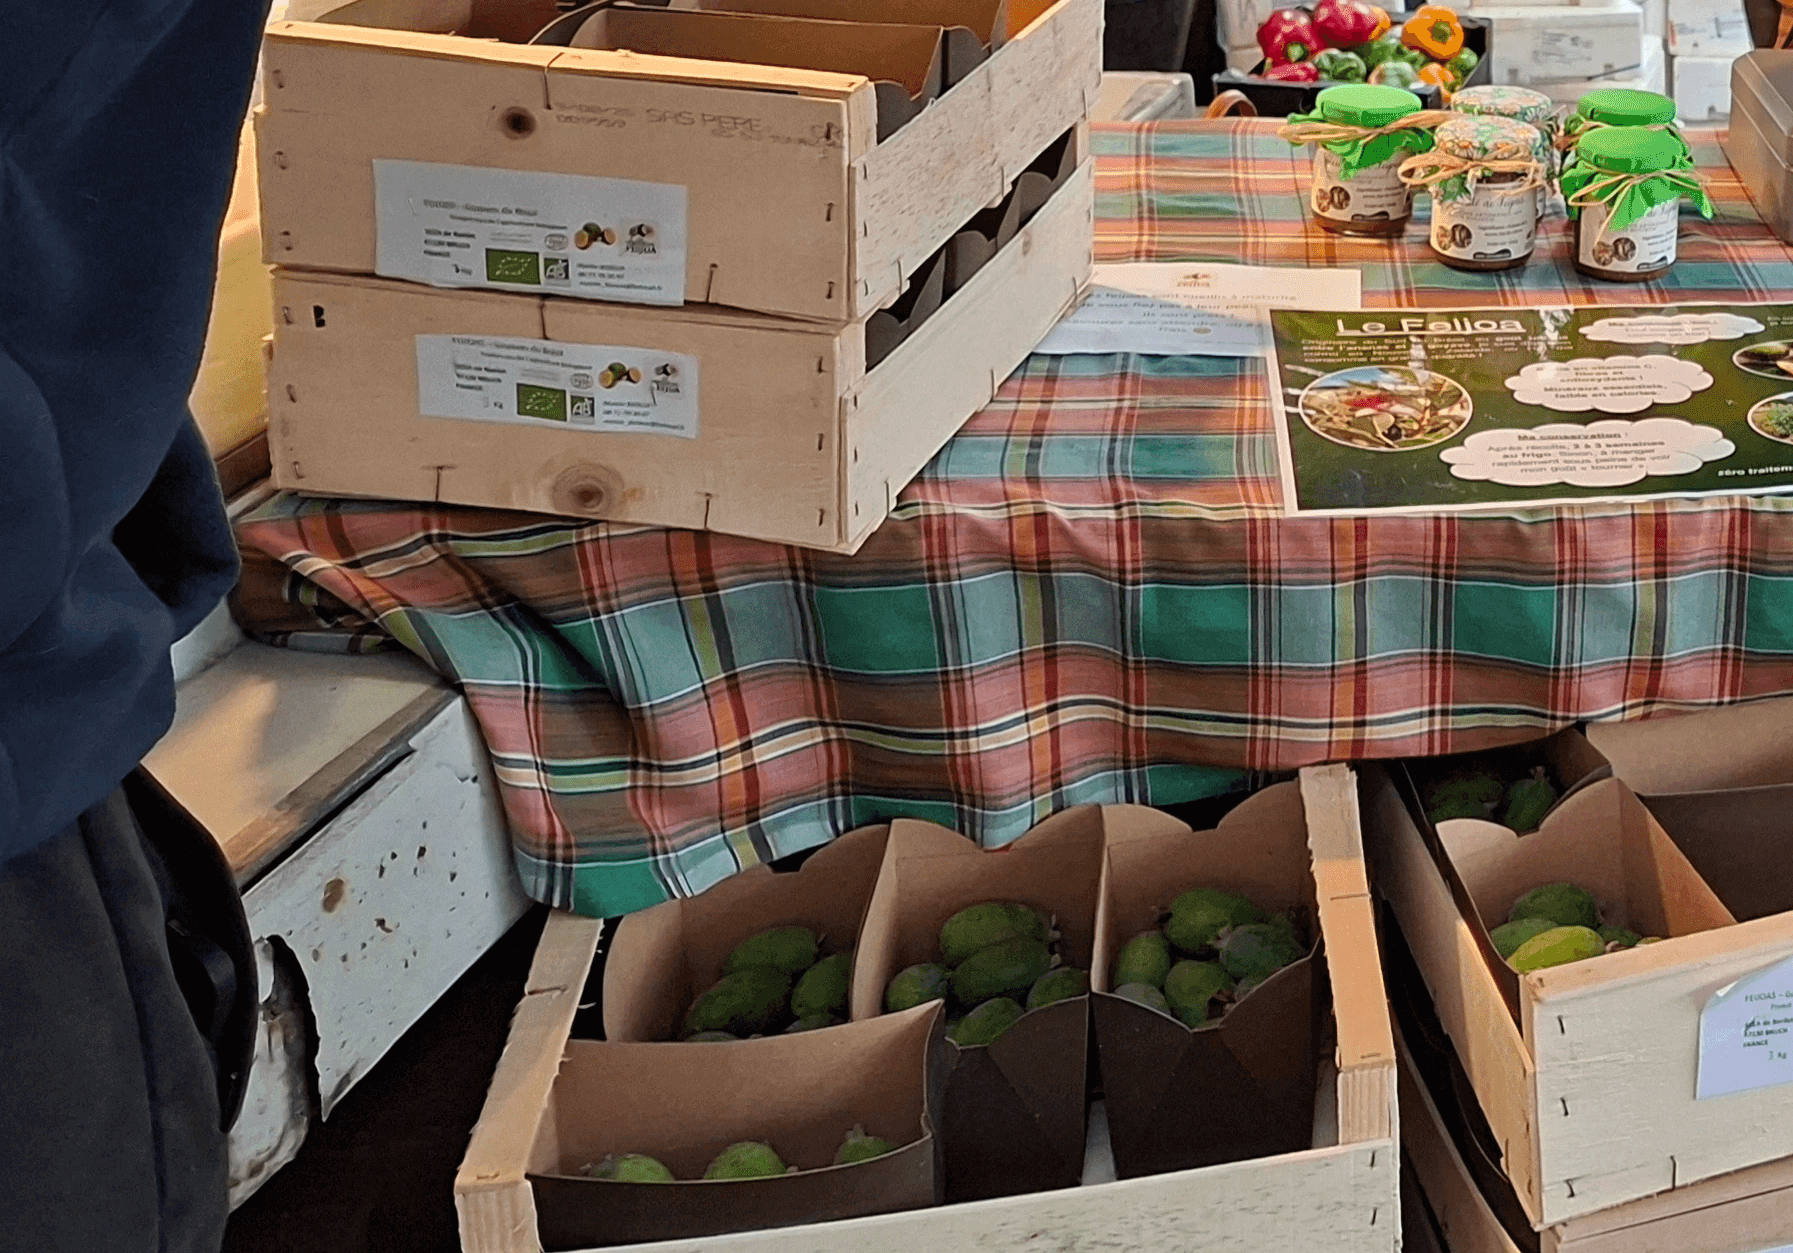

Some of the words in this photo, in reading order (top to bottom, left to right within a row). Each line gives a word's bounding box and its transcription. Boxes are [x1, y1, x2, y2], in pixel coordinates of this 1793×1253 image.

[1337, 318, 1386, 334] Le
[1400, 316, 1523, 334] Feijoa
[1540, 432, 1622, 440] conservation
[1488, 444, 1523, 453] Après
[1526, 443, 1570, 451] récolte,
[1605, 440, 1665, 448] semaines
[1611, 448, 1656, 456] manger
[1491, 458, 1559, 468] rapidement
[1595, 456, 1628, 464] peine
[1550, 464, 1576, 473] goût
[1718, 469, 1746, 477] zéro
